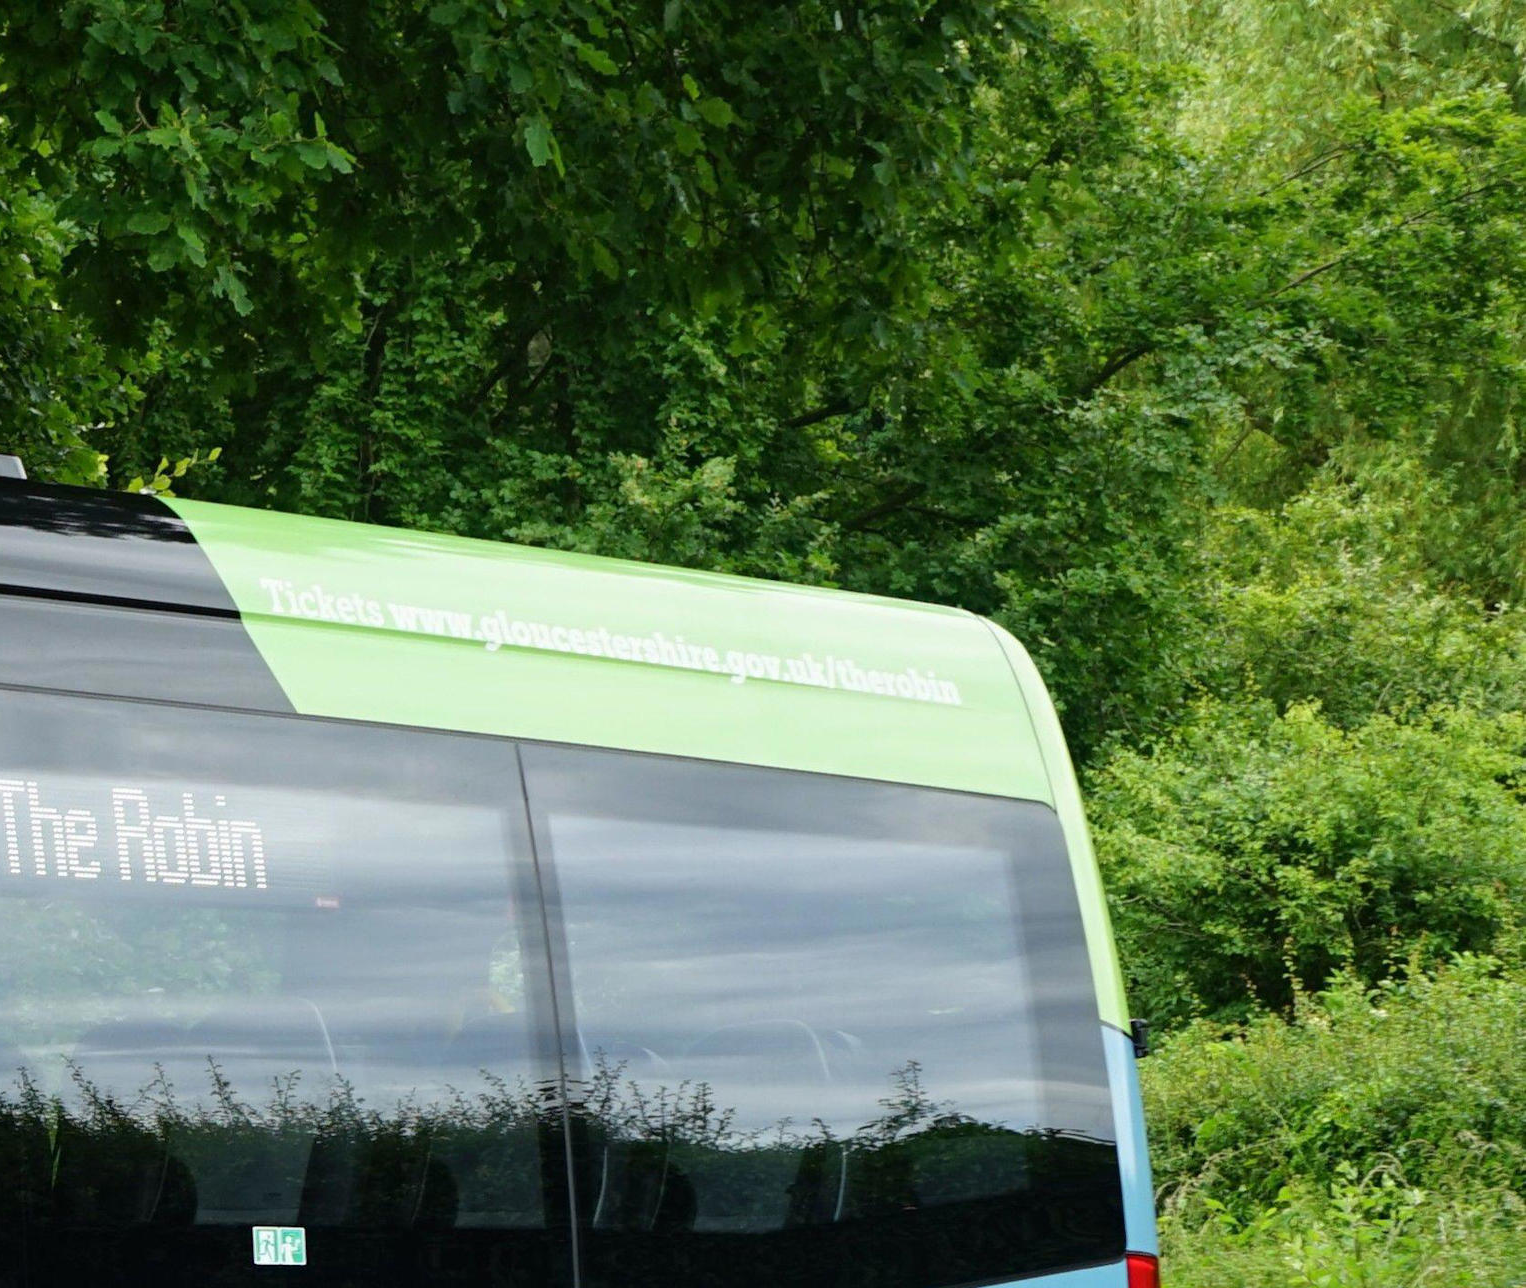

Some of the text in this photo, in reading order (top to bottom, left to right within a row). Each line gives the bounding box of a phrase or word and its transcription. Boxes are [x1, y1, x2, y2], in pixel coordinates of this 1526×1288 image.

[258, 577, 962, 705] Tickets www.gloucestershire.gov.uk/therobin
[112, 786, 267, 889] Robin
